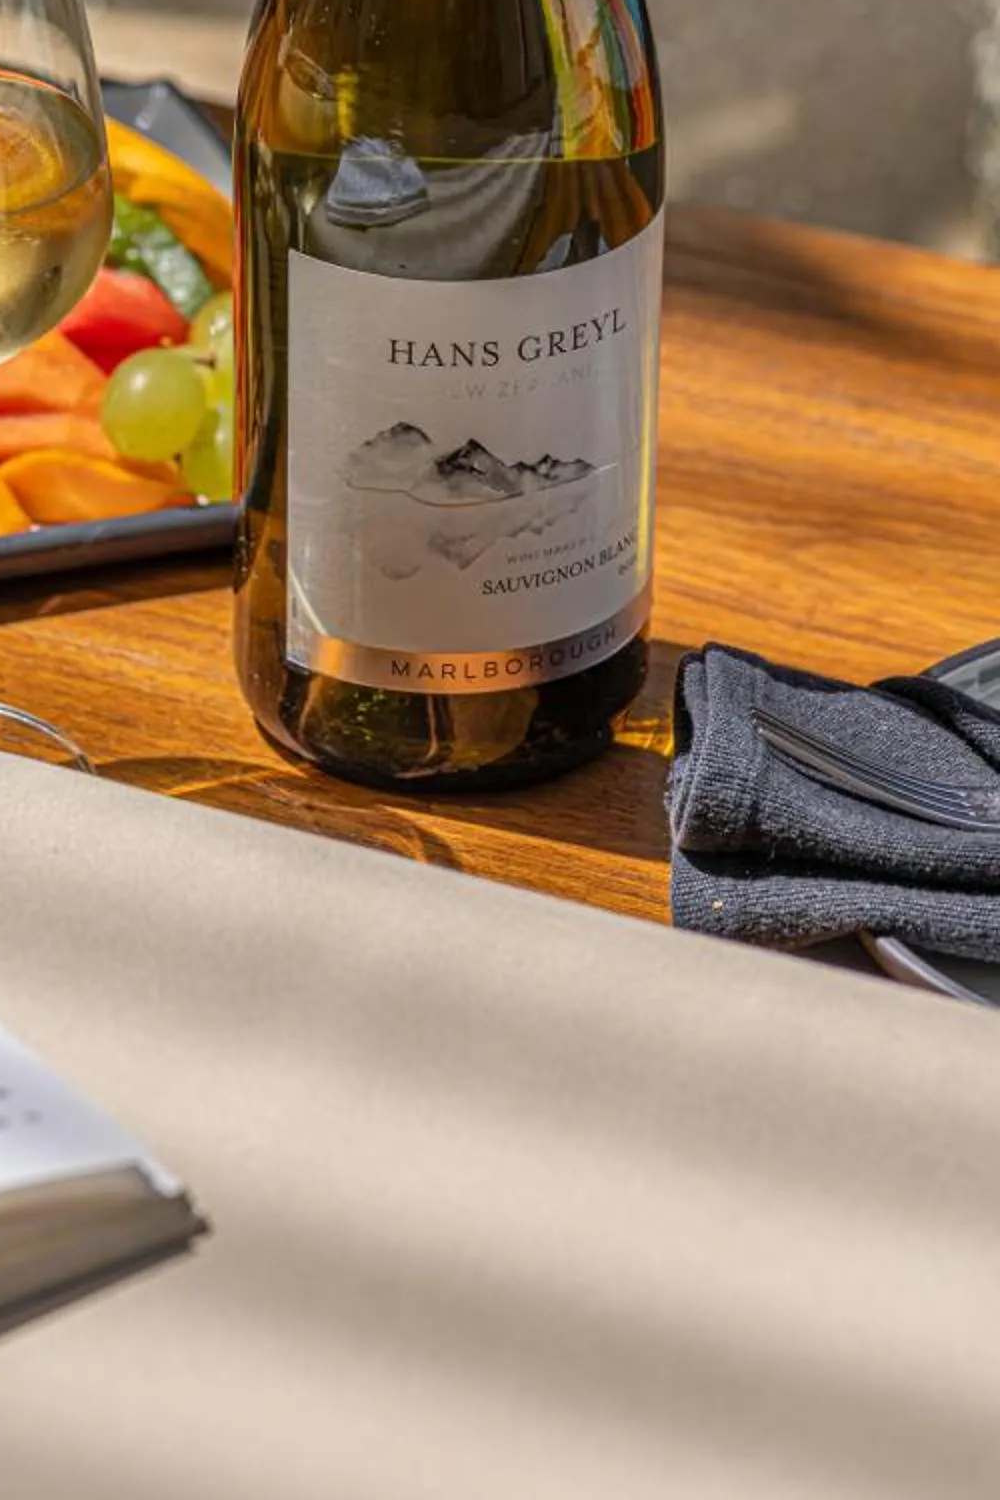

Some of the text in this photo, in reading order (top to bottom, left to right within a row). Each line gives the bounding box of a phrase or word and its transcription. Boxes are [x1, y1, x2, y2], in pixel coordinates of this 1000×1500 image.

[388, 308, 626, 367] HANS GREYL
[482, 555, 595, 596] SAUVIGNON
[391, 625, 616, 680] MARLBOROUGH
